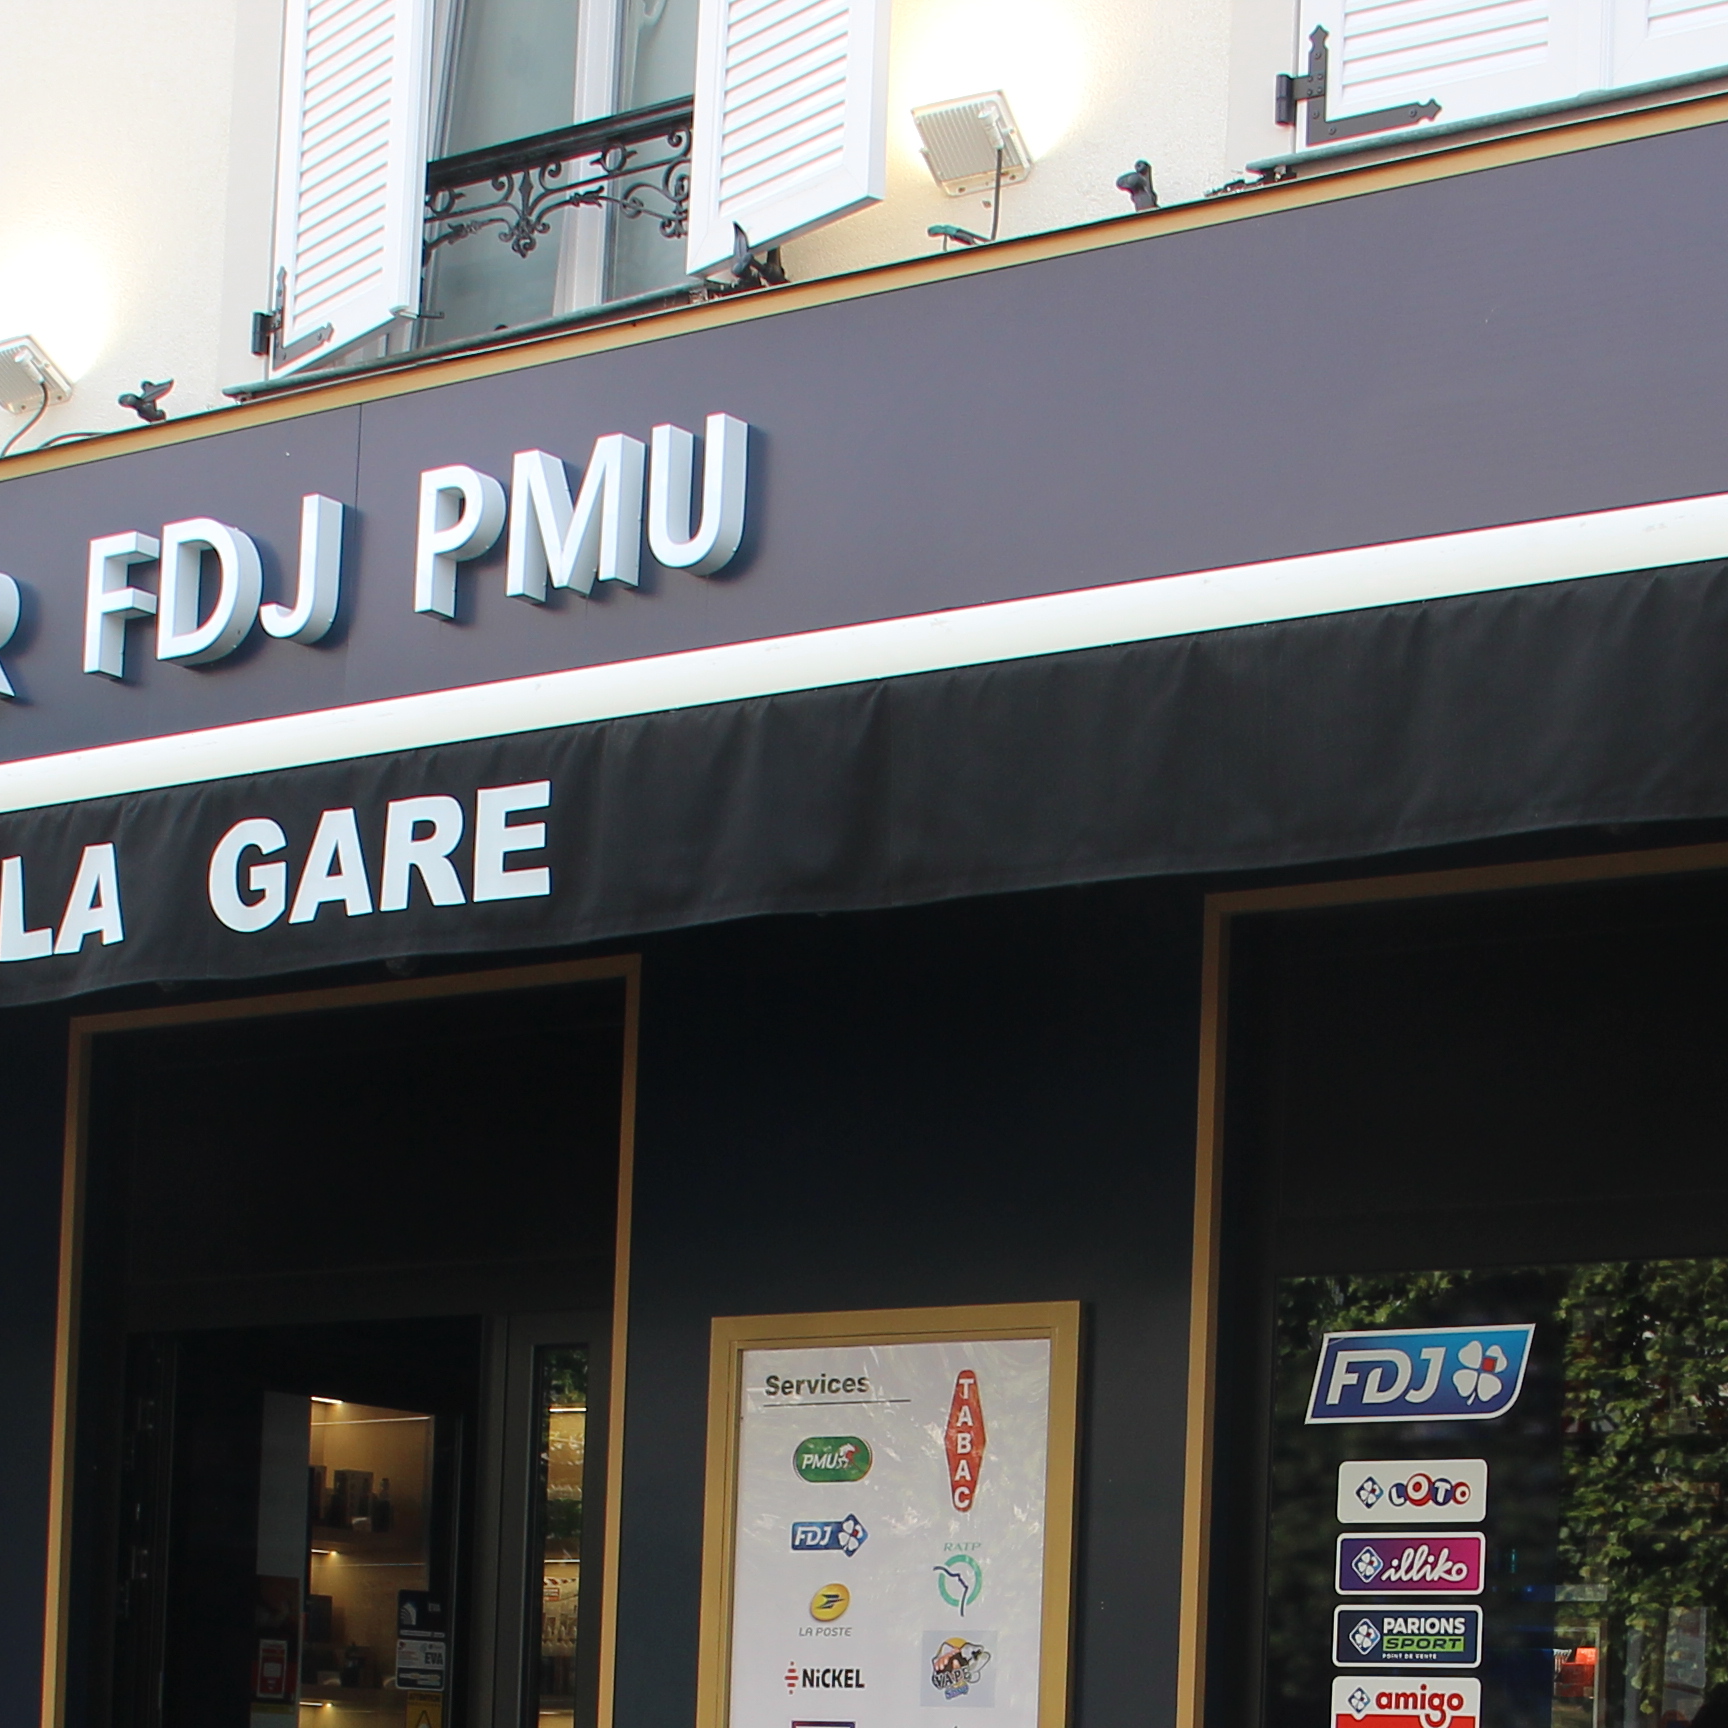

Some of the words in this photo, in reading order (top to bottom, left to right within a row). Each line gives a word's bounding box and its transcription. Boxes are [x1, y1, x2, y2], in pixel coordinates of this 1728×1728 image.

[84, 492, 345, 680] FDJ
[414, 412, 749, 620] PMU
[209, 779, 553, 934] GARE
[764, 1373, 870, 1398] Services
[1325, 1347, 1447, 1405] FDJ
[952, 1377, 975, 1510] TABAC
[801, 1453, 837, 1470] PMU
[1388, 1472, 1471, 1507] LOTO
[795, 1526, 832, 1546] FDJ
[944, 1541, 982, 1552] RATP
[1381, 1544, 1468, 1583] illiko
[799, 1627, 812, 1637] LA
[815, 1627, 852, 1637] POSTE
[1383, 1617, 1466, 1635] PARIONS
[1384, 1636, 1463, 1651] SPORT
[425, 1652, 444, 1666] EVA
[1375, 1684, 1464, 1727] amigo
